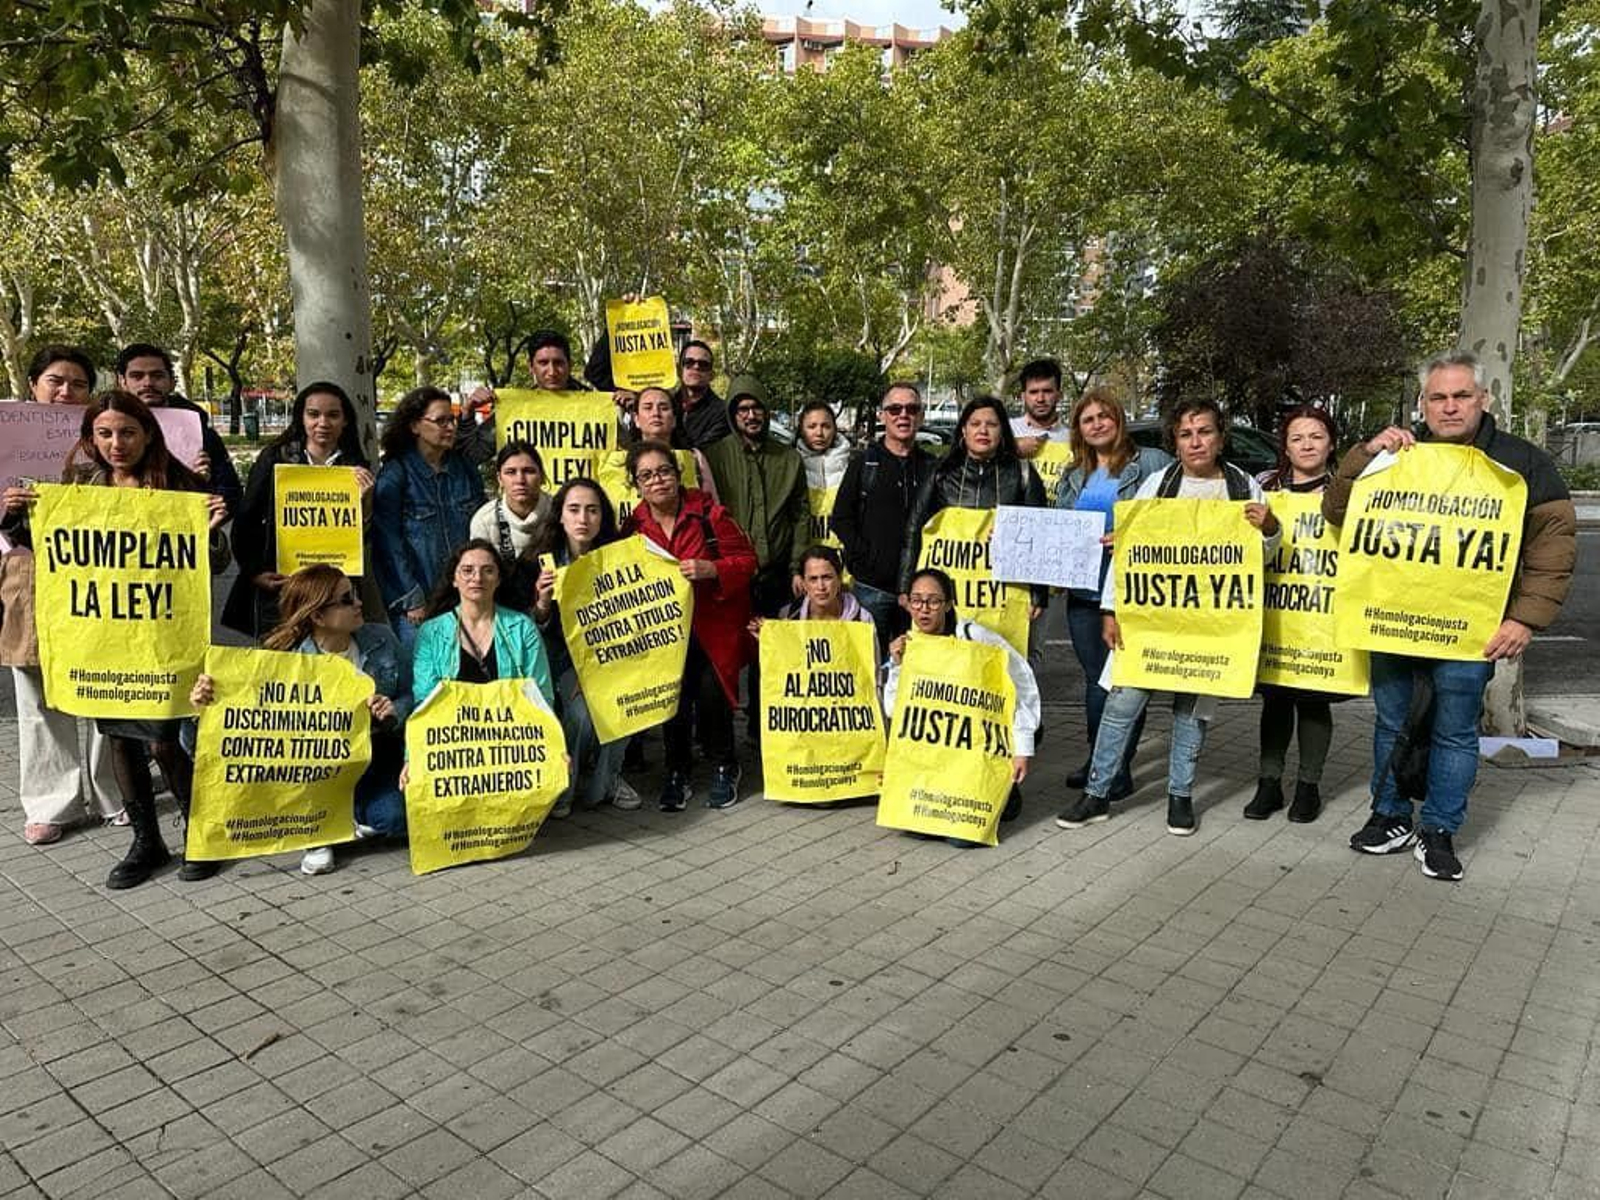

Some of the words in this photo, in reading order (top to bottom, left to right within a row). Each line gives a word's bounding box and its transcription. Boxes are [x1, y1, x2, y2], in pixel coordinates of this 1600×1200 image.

[615, 334, 647, 353] JUSTA
[648, 332, 669, 351] YA!
[506, 420, 608, 450] ¡CUMPLAN
[283, 507, 327, 528] JUSTA
[332, 507, 357, 528] YA!
[1365, 489, 1503, 520] ¡HOMOLOGACIÓN
[1292, 512, 1325, 544] ¡NO
[45, 528, 197, 573] ¡CUMPLAN
[1128, 541, 1243, 567] ¡HOMOLOGACIÓN
[1349, 517, 1442, 565] JUSTA
[1456, 528, 1510, 572] YA!
[593, 572, 615, 598] ¡NO
[618, 569, 627, 586] A
[626, 563, 645, 584] LA
[965, 579, 1006, 608] LEY!
[1124, 573, 1200, 609] JUSTA
[1209, 574, 1254, 610] YA!
[71, 580, 102, 619] LA
[111, 582, 173, 620] LEY!
[577, 577, 676, 627] DISCRIMINACIÓN
[585, 617, 632, 646] CONTRA
[634, 600, 683, 632] TÍTULOS
[1364, 607, 1469, 631] #Homologacionjusta
[596, 631, 676, 665] EXTRANJEROS
[1370, 624, 1459, 645] #Homologacionya
[805, 638, 830, 670] ¡NO
[1142, 647, 1230, 667] #Homologacionjusta
[69, 669, 178, 686] #Homologacionjusta
[784, 673, 804, 698] AL
[807, 673, 855, 698] ABUSO
[1145, 662, 1221, 681] #Homologacionya
[76, 686, 171, 702] #Homologacionya
[259, 681, 285, 708] ¡NO
[289, 682, 300, 703] A
[302, 684, 322, 704] LA
[910, 680, 1007, 714] ¡HOMOLOGACIÓN
[224, 707, 353, 732] DISCRIMINACIÓN
[456, 704, 481, 725] ¡NO
[484, 706, 494, 723] A
[496, 705, 514, 723] LA
[768, 701, 876, 732] BUROCRÁTICO!
[221, 736, 286, 759] CONTRA
[289, 734, 351, 760] TÍTULOS
[427, 723, 544, 746] DISCRIMINACIÓN
[898, 706, 972, 750] JUSTA
[980, 718, 1013, 759] YA!
[427, 750, 487, 772] CONTRA
[489, 741, 546, 767] TÍTULOS
[225, 765, 331, 784] EXTRANJEROS
[434, 773, 533, 798] EXTRANJEROS
[536, 769, 542, 790] !
